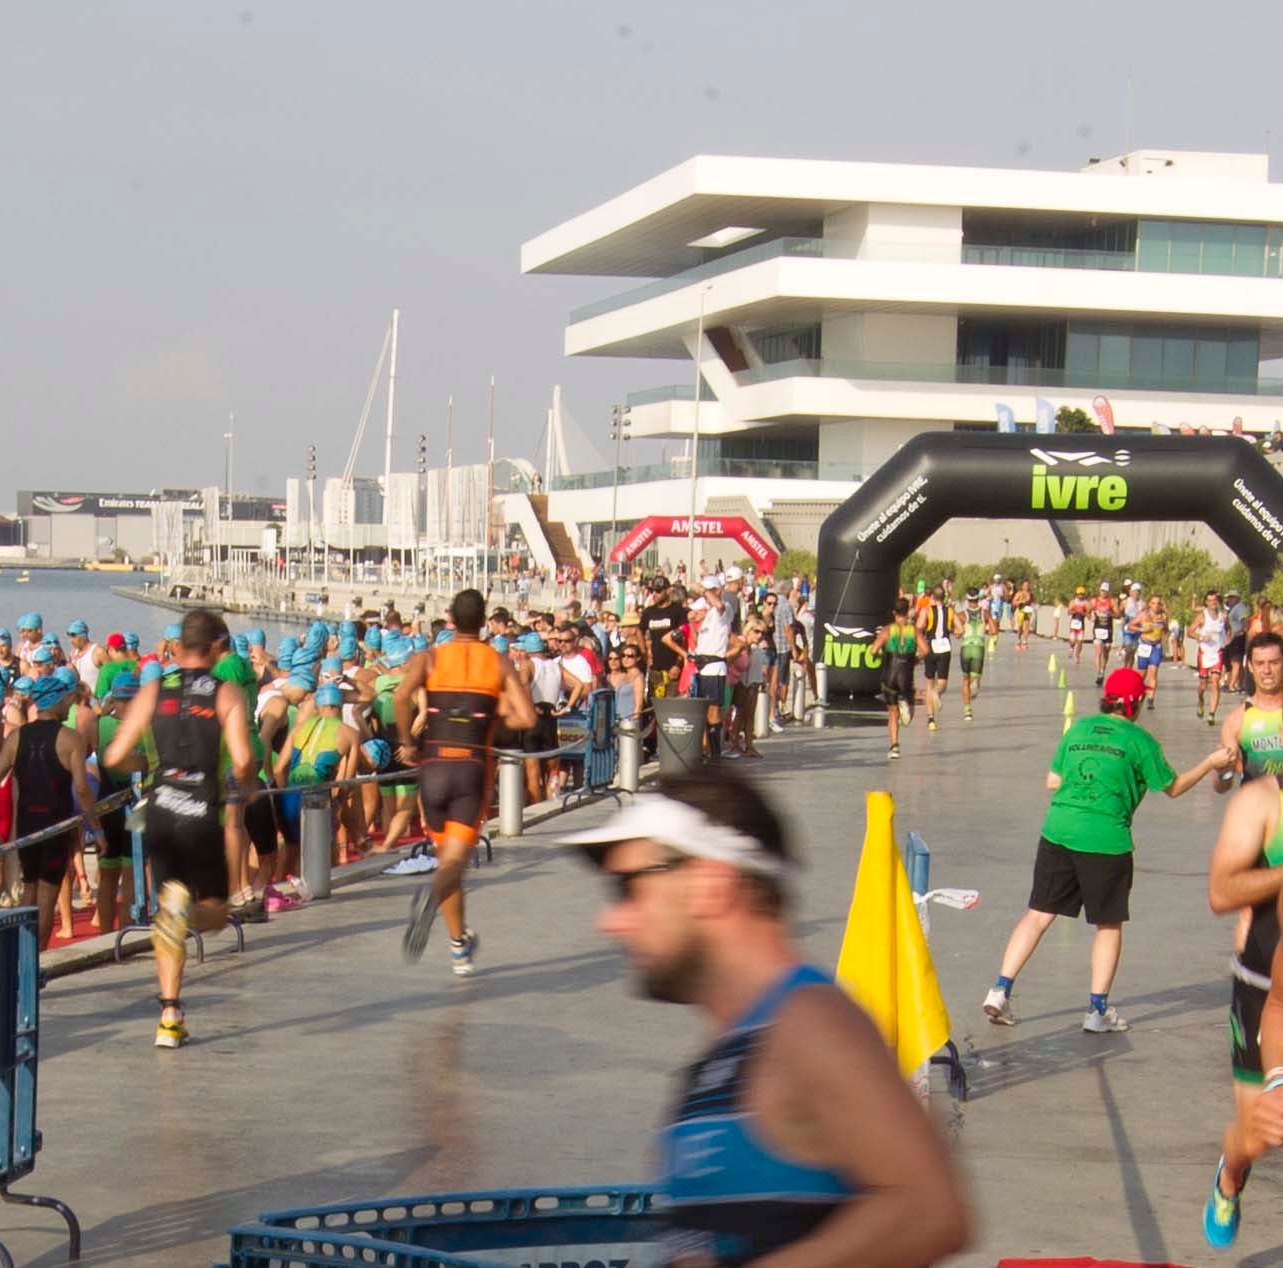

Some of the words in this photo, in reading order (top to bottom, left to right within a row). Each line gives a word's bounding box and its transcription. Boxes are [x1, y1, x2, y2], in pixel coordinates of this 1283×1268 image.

[1031, 464, 1128, 511] ivre
[671, 519, 724, 534] AMSTEL
[876, 510, 910, 542] cuidamos
[908, 501, 920, 512] de
[1232, 498, 1265, 532] cuidamos
[1261, 529, 1274, 541] de
[625, 527, 654, 555] AMSTEL
[741, 530, 768, 559] AMSTEL
[824, 633, 883, 669] ivre
